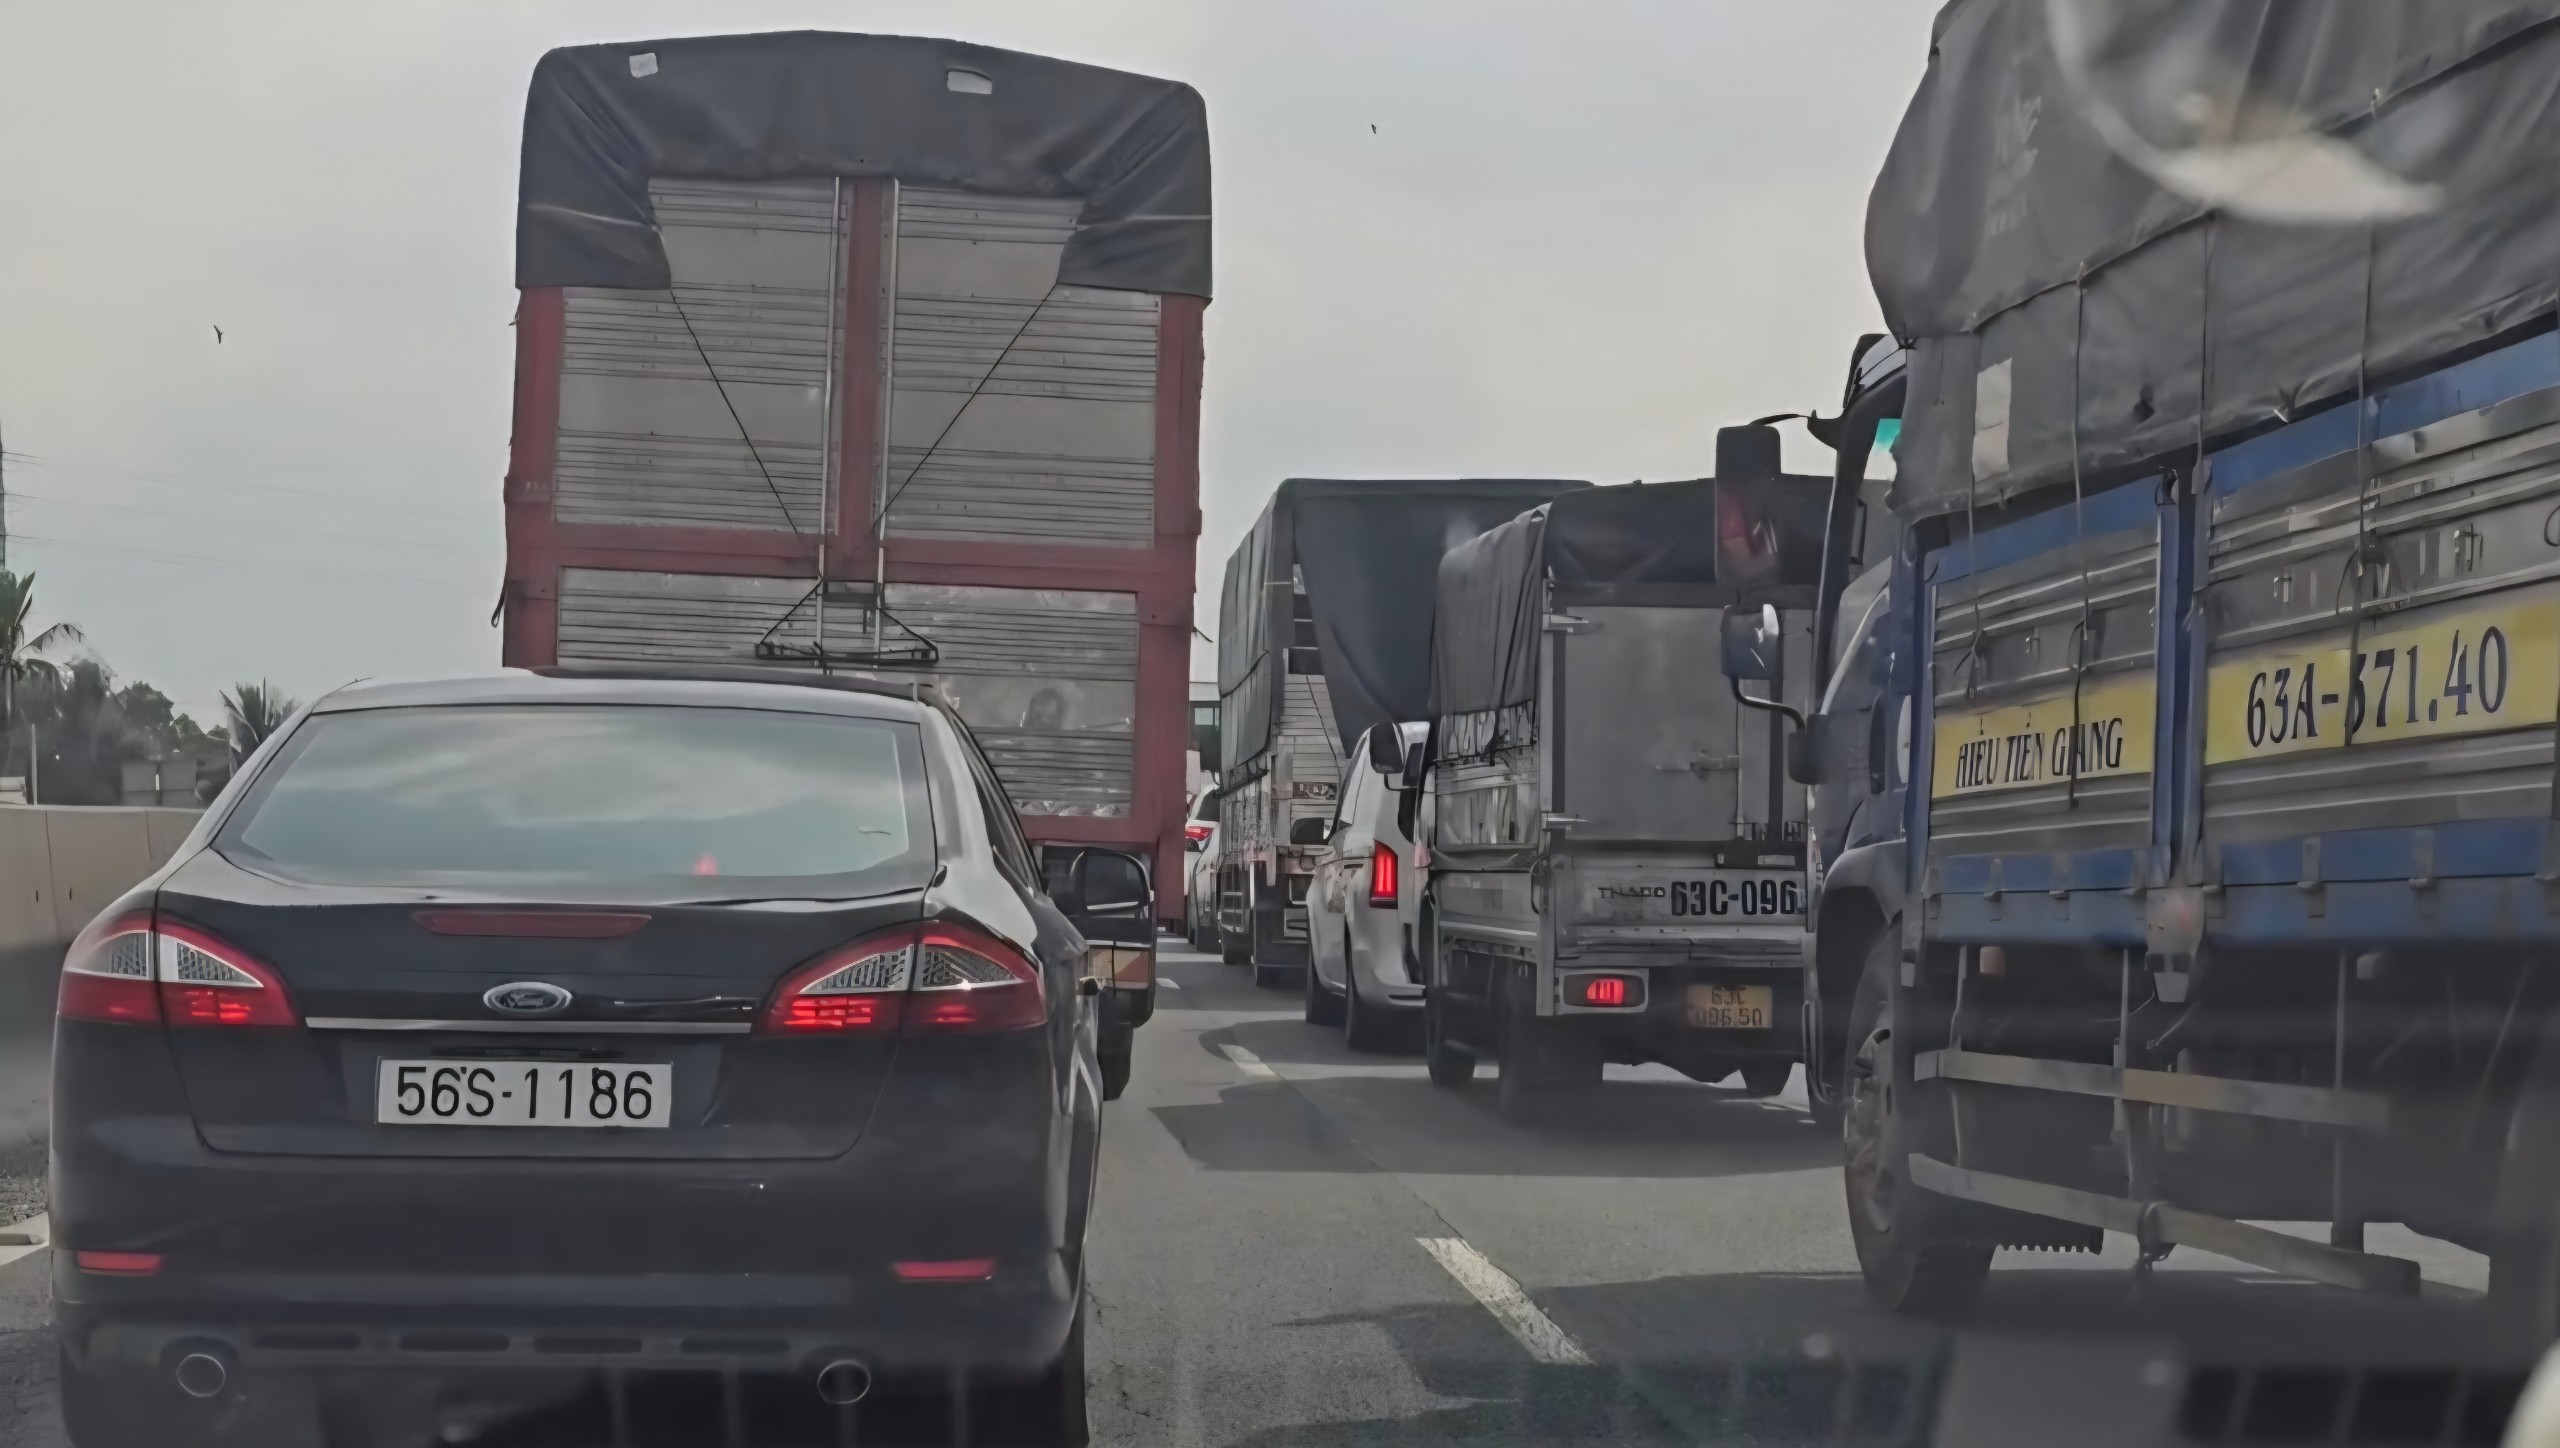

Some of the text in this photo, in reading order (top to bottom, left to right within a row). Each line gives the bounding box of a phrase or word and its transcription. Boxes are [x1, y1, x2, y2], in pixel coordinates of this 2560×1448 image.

[2247, 625, 2507, 748] 63A-371.40
[2052, 717, 2123, 776] GIANG
[397, 1066, 654, 1120] 56S-1186
